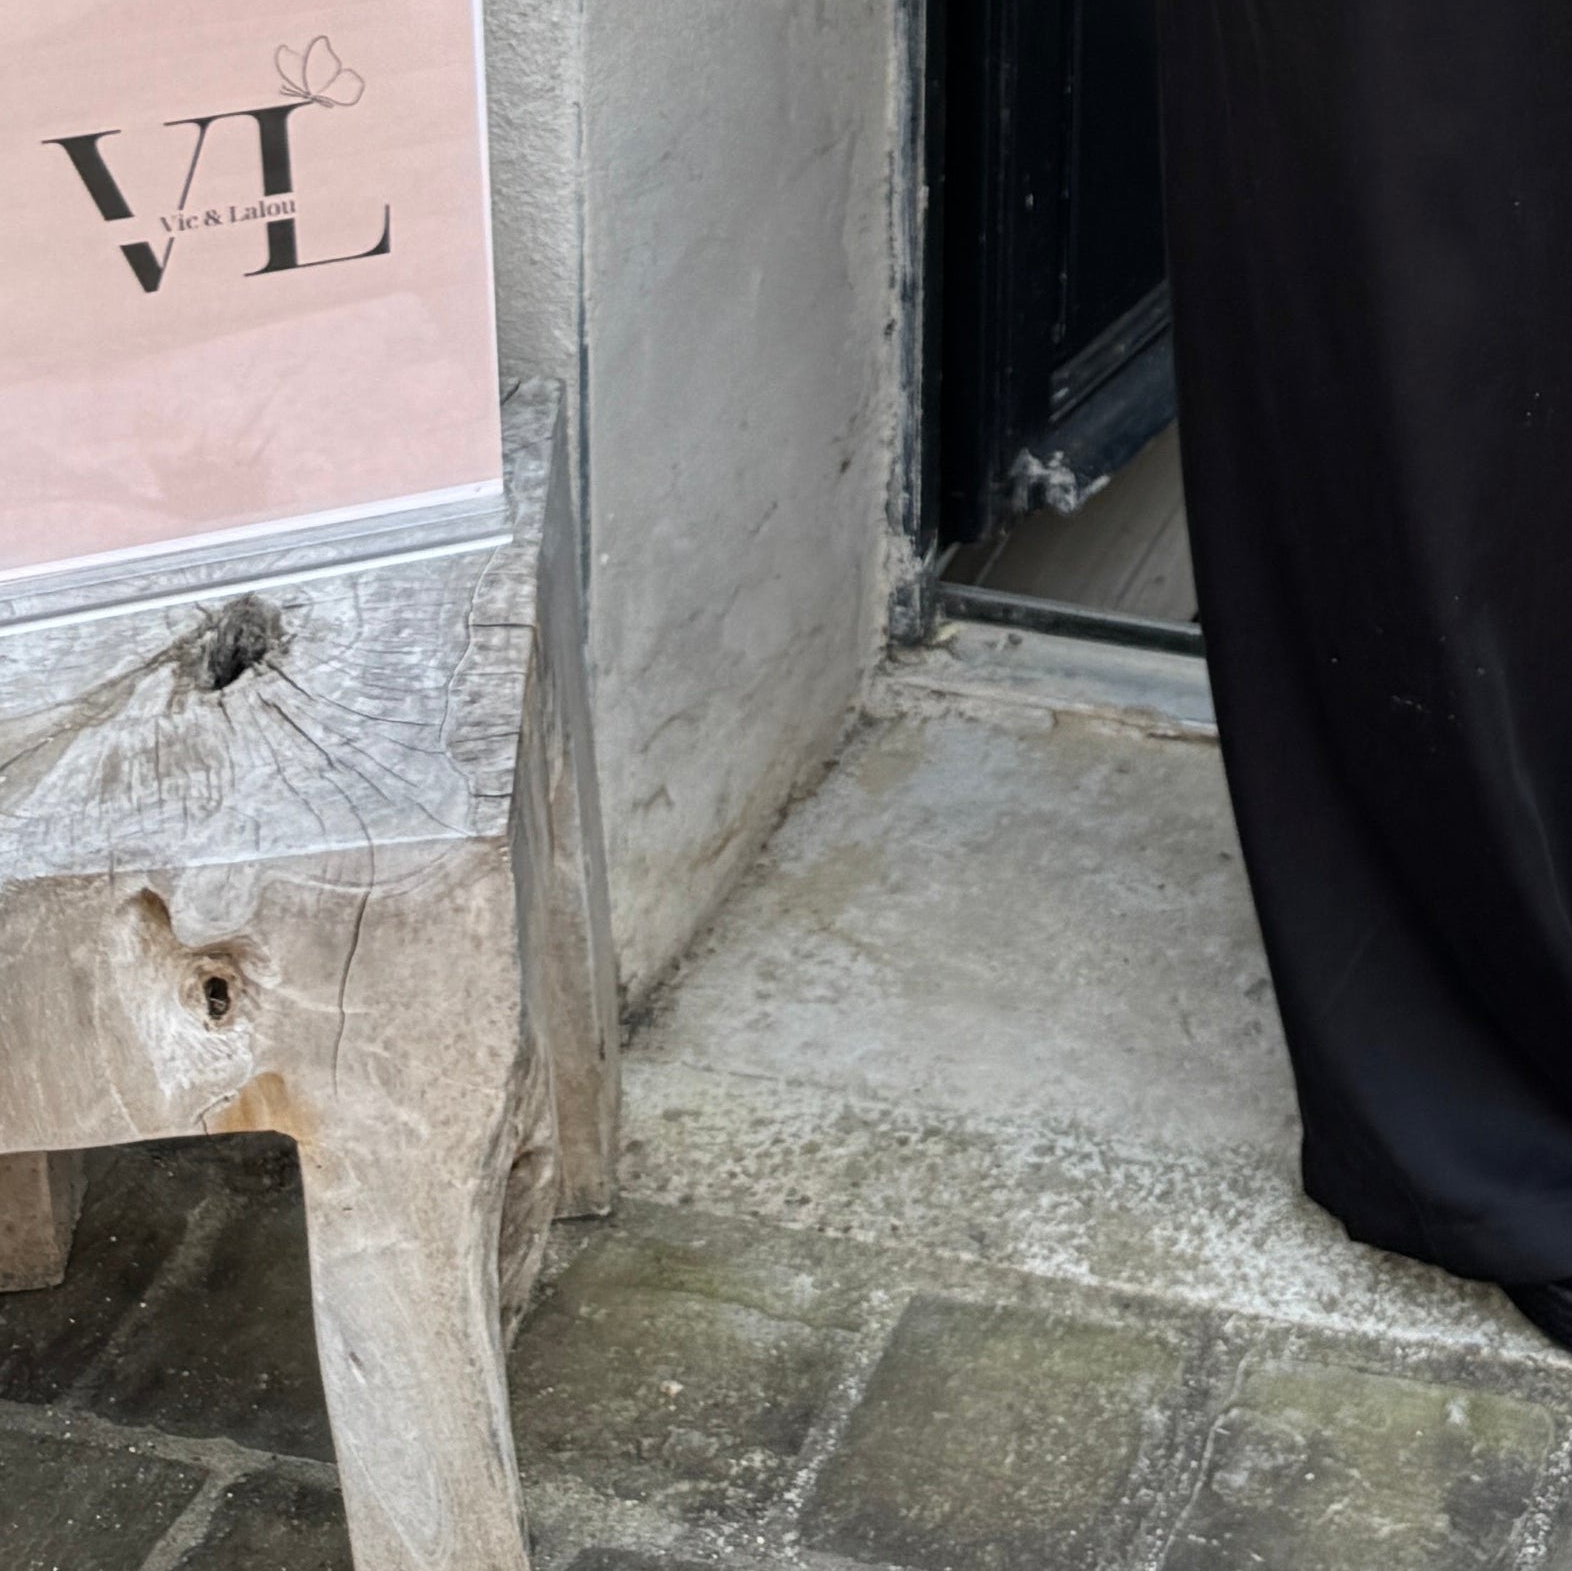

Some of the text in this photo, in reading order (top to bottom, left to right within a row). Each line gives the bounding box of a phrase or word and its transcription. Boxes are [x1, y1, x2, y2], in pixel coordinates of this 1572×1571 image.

[41, 101, 390, 293] VL
[159, 199, 296, 233] Vic & Lalou
